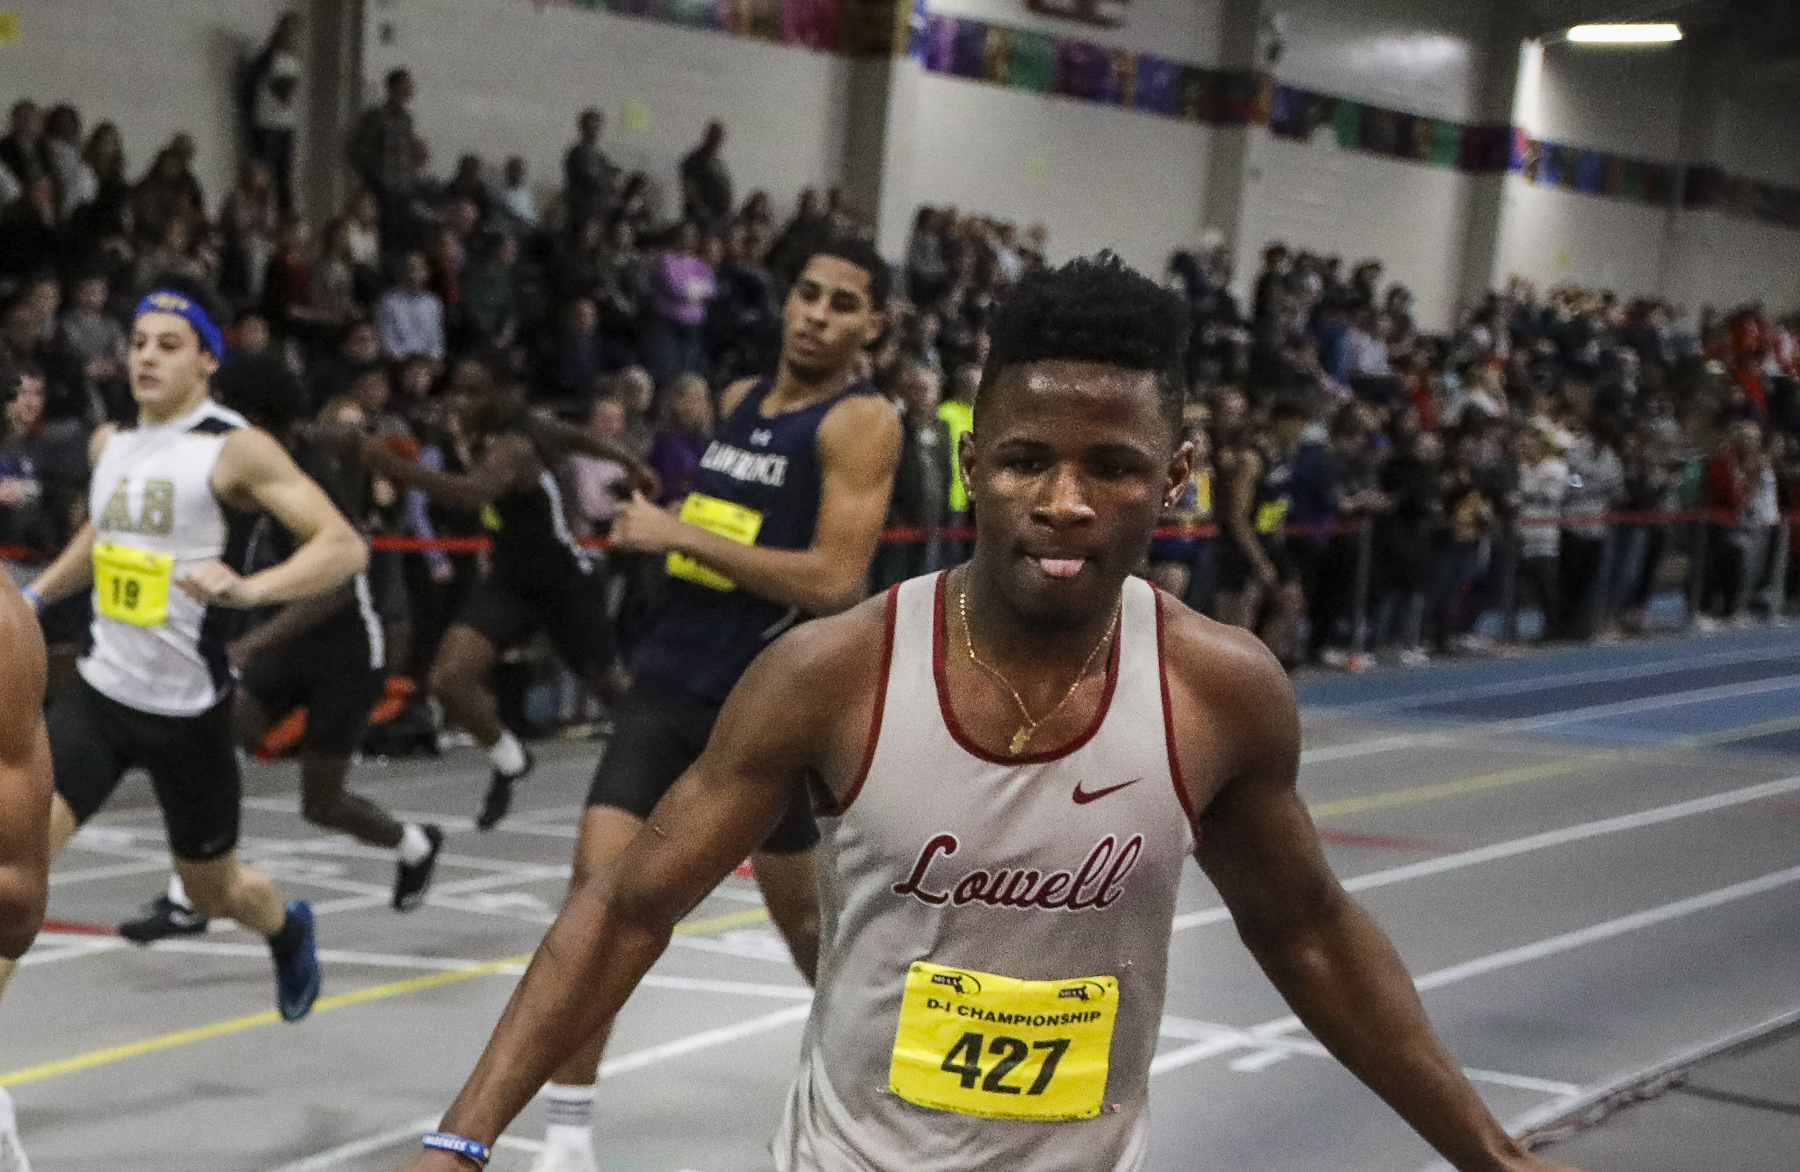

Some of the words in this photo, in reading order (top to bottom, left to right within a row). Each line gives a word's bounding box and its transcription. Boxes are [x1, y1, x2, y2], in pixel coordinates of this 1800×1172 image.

[892, 831, 1145, 912] Lowell
[957, 1003, 1101, 1027] CHAMPIONSHIP
[940, 1030, 1072, 1097] 427
